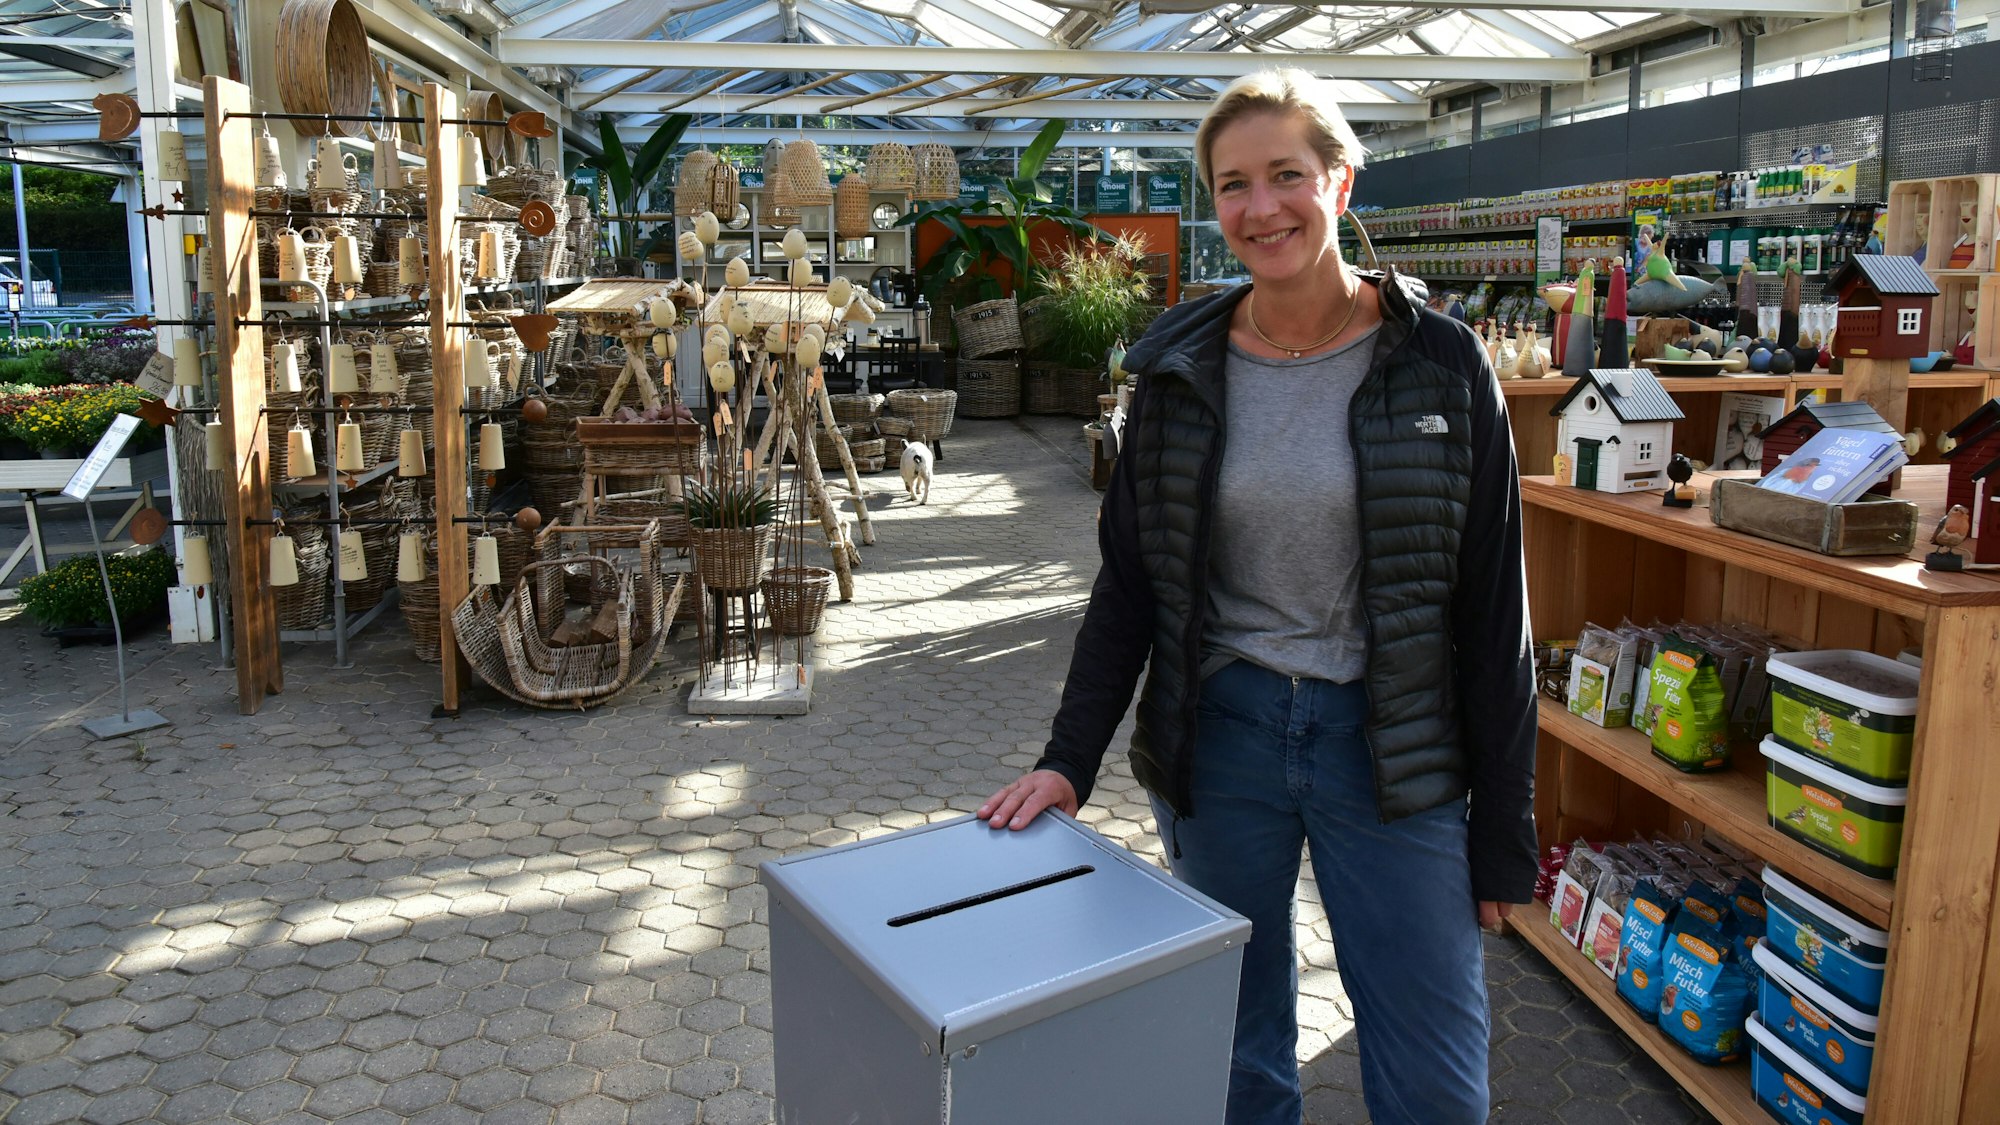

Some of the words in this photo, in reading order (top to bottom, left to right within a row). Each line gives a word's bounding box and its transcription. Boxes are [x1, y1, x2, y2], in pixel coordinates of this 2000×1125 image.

[978, 310, 993, 319] 1915
[968, 372, 984, 380] 1915
[1835, 436, 1867, 449] Vögel
[1822, 446, 1861, 460] füttern
[1805, 788, 1838, 808] Welzhofer
[1639, 903, 1664, 923] Welzho
[1689, 901, 1717, 921] Welzhofe
[1683, 937, 1717, 961] Welzhofe
[1669, 952, 1704, 981] Misch
[1738, 954, 1760, 978] Misc
[1673, 971, 1709, 999] Futter
[1787, 1077, 1818, 1105] Welzhofer
